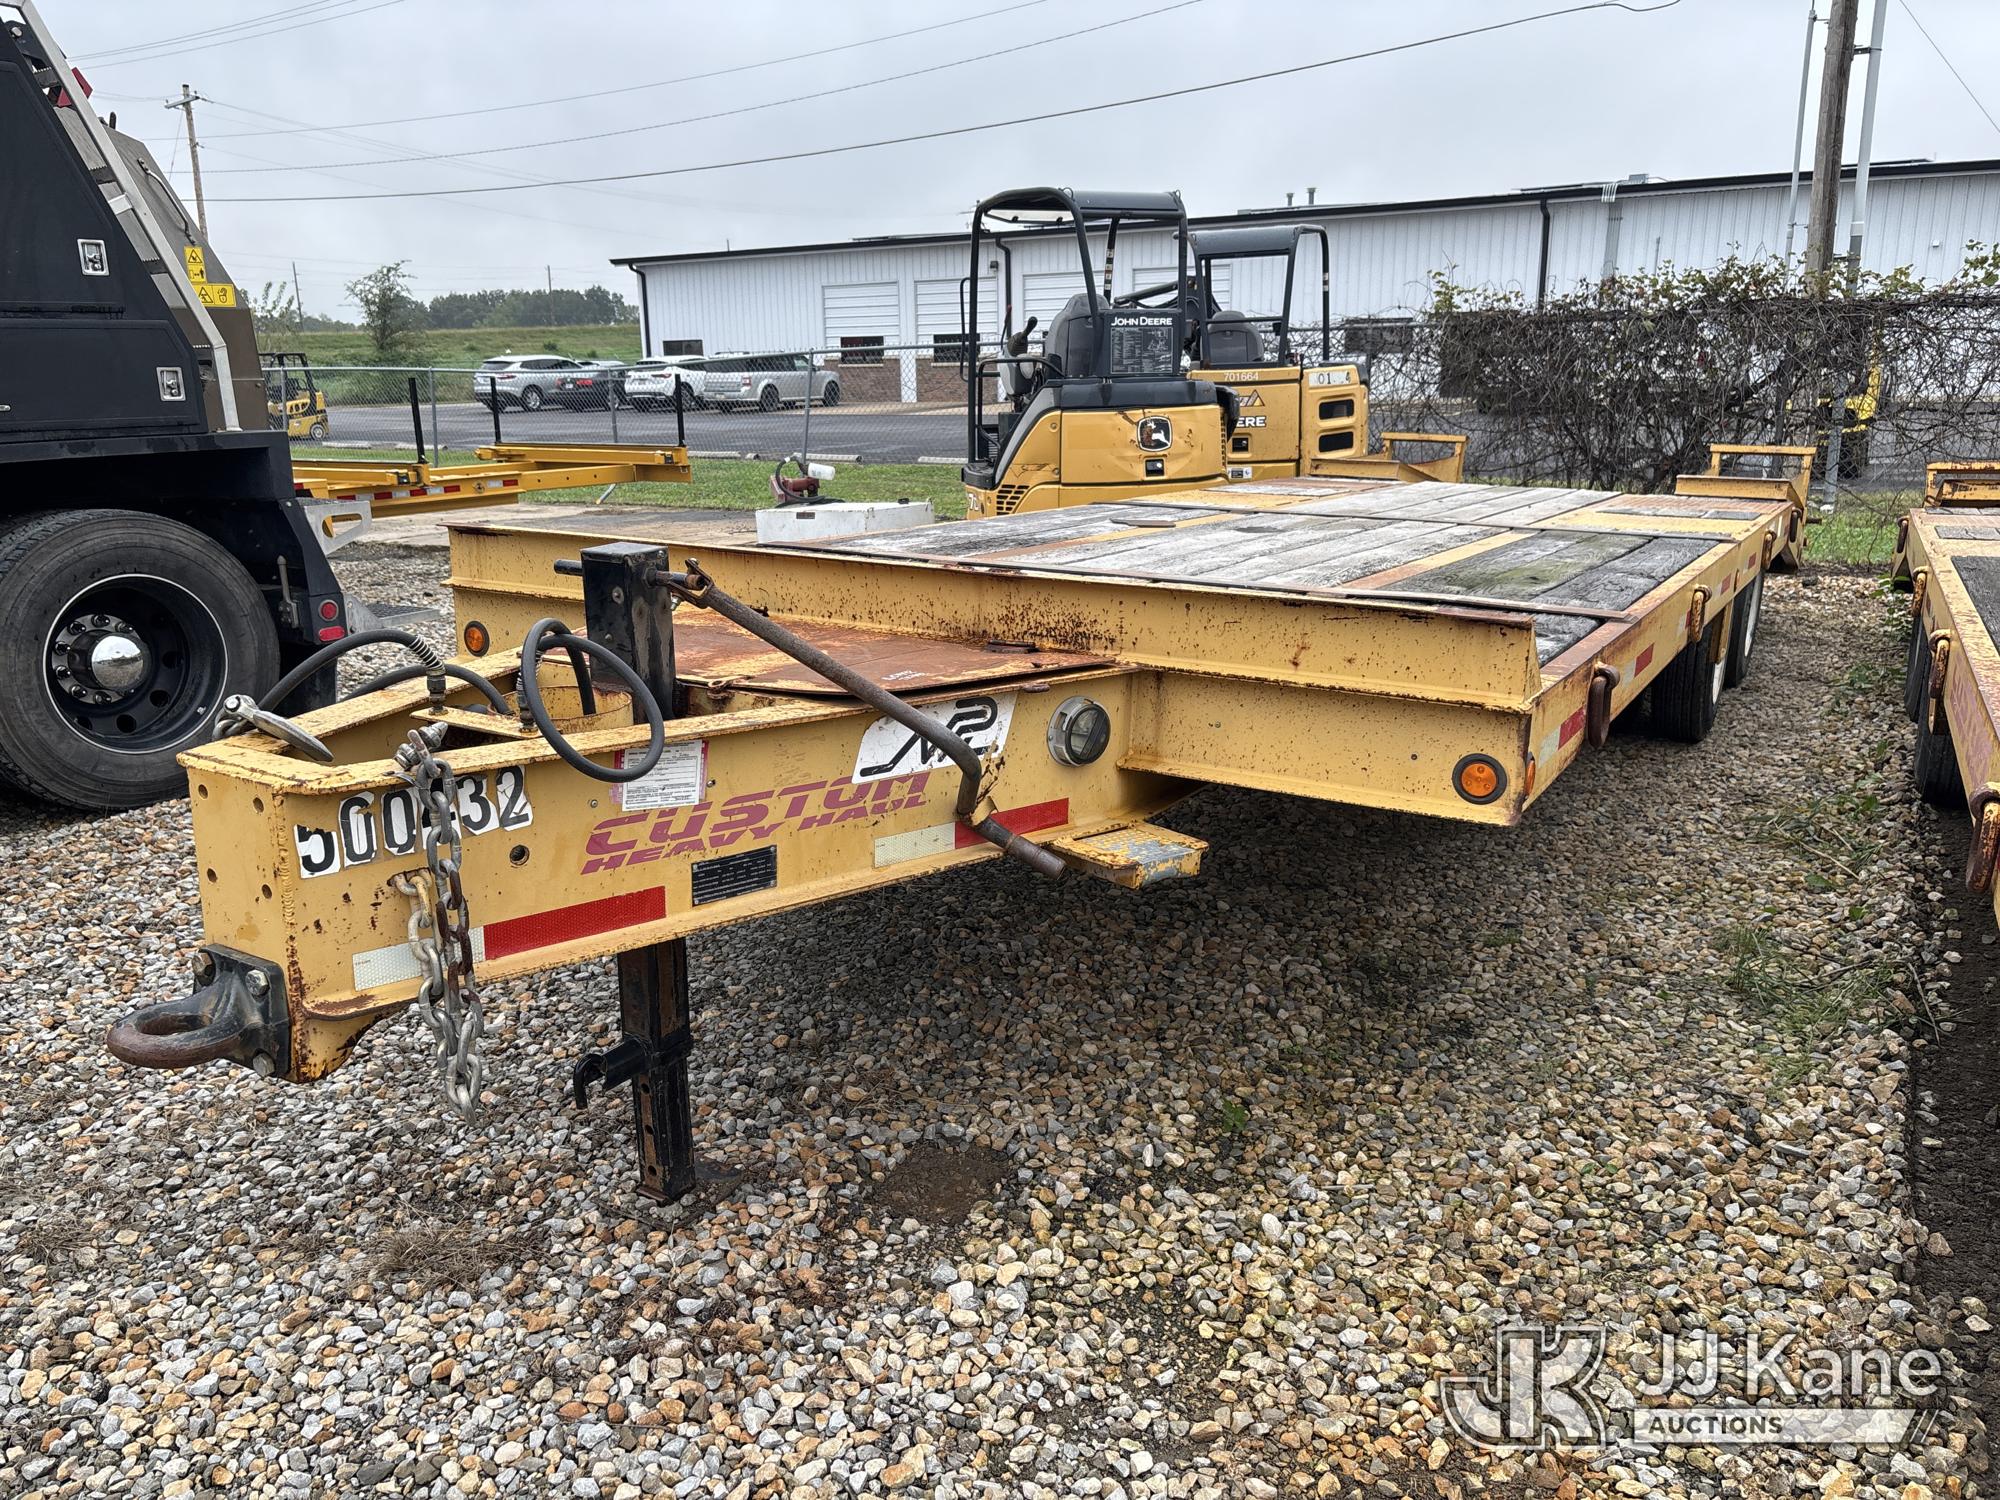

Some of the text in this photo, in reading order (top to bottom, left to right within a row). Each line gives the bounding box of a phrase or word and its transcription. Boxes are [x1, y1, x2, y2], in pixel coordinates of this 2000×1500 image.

[1111, 316, 1173, 326] JOHN DEERE
[1224, 372, 1259, 382] 701664
[580, 795, 928, 876] HEAVY HAUL
[584, 770, 931, 857] CUSTOM
